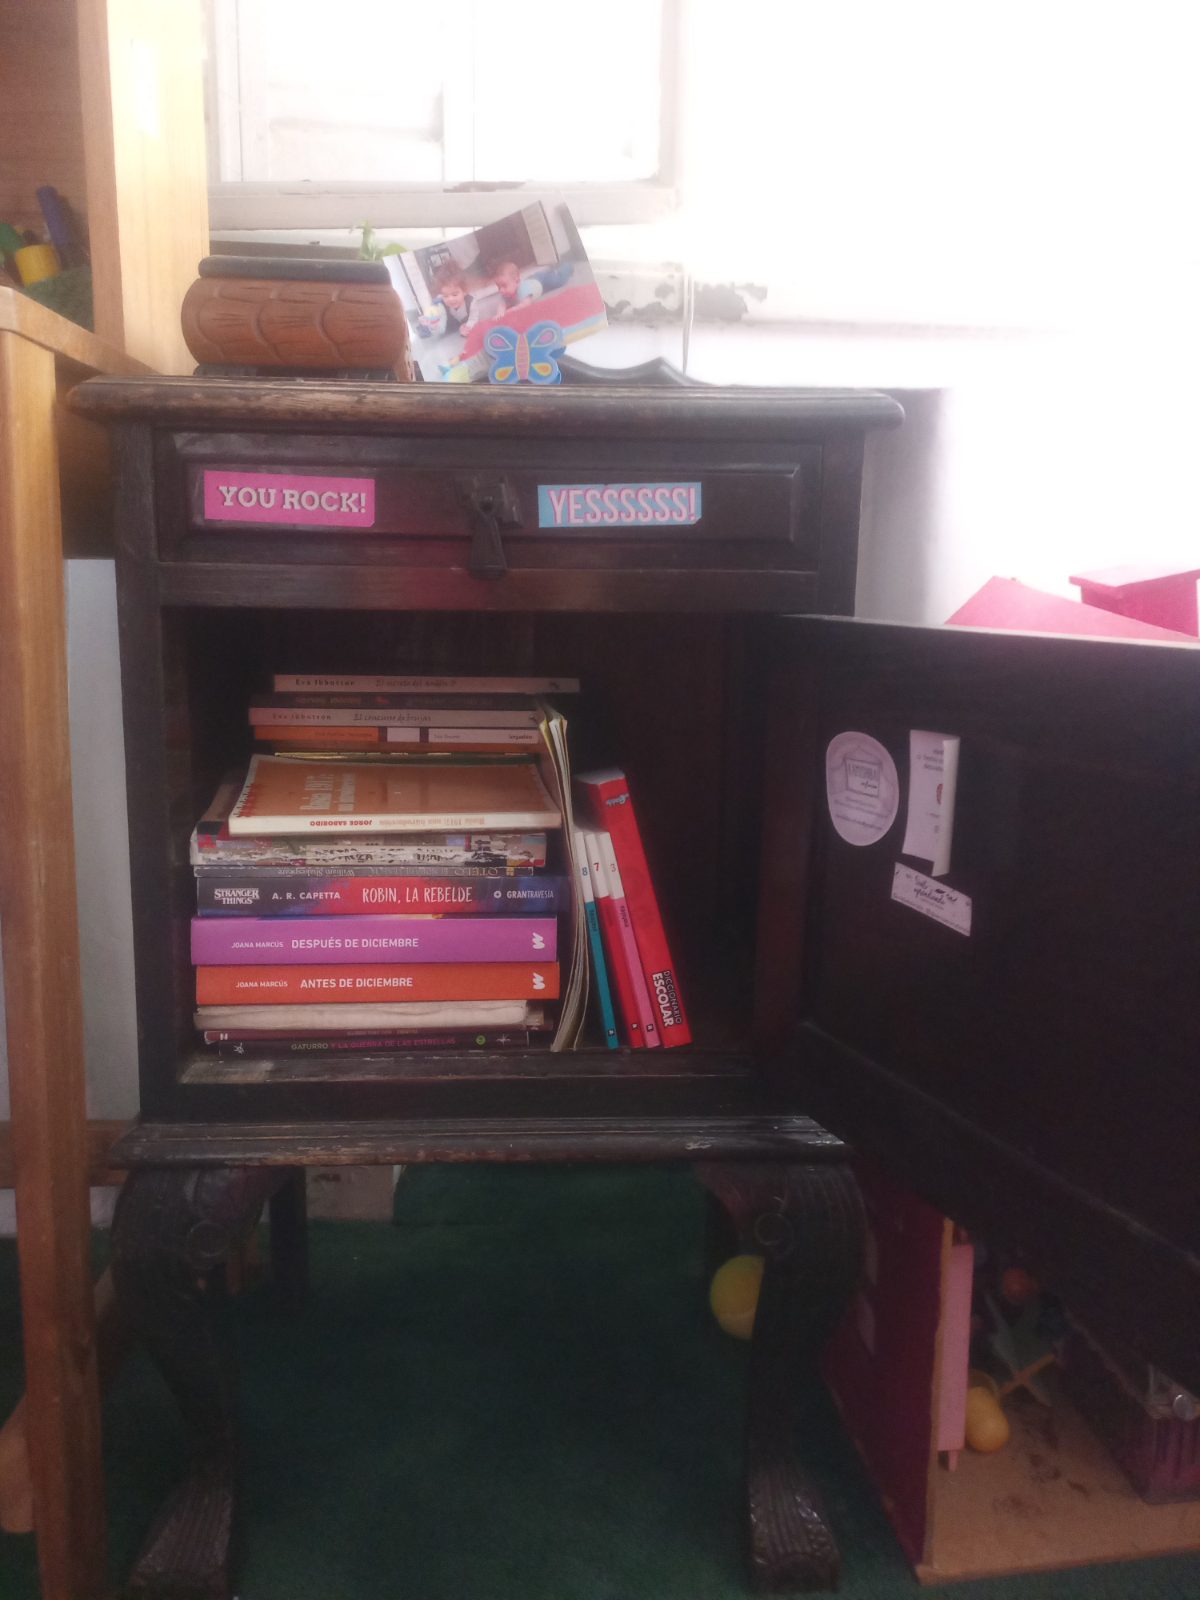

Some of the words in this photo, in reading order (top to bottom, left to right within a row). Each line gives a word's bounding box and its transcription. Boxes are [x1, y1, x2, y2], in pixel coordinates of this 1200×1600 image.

[219, 486, 276, 508] YOU
[283, 488, 366, 513] ROCK!
[549, 487, 696, 524] YESSSSSS!
[309, 820, 347, 828] SABORIDO
[349, 819, 373, 827] JORGE
[325, 868, 355, 878] William
[454, 867, 499, 877] OTELO
[214, 888, 260, 900] STRANGER
[272, 892, 282, 900] A.
[286, 892, 296, 900] R.
[299, 892, 341, 900] CAPETTA
[362, 887, 401, 904] ROBIN,
[406, 887, 419, 903] LA
[424, 886, 473, 903] REBELDE
[291, 937, 342, 949] DESPUÉS
[344, 939, 358, 948] DE
[361, 938, 419, 948] DICIEMBRE
[300, 979, 336, 989] ANTES
[339, 978, 353, 988] DE
[355, 977, 413, 988] DICIEMBRE
[652, 971, 674, 1027] ESCOLAR
[662, 969, 683, 1024] DICCIONARIO
[291, 1042, 328, 1050] GATURRO
